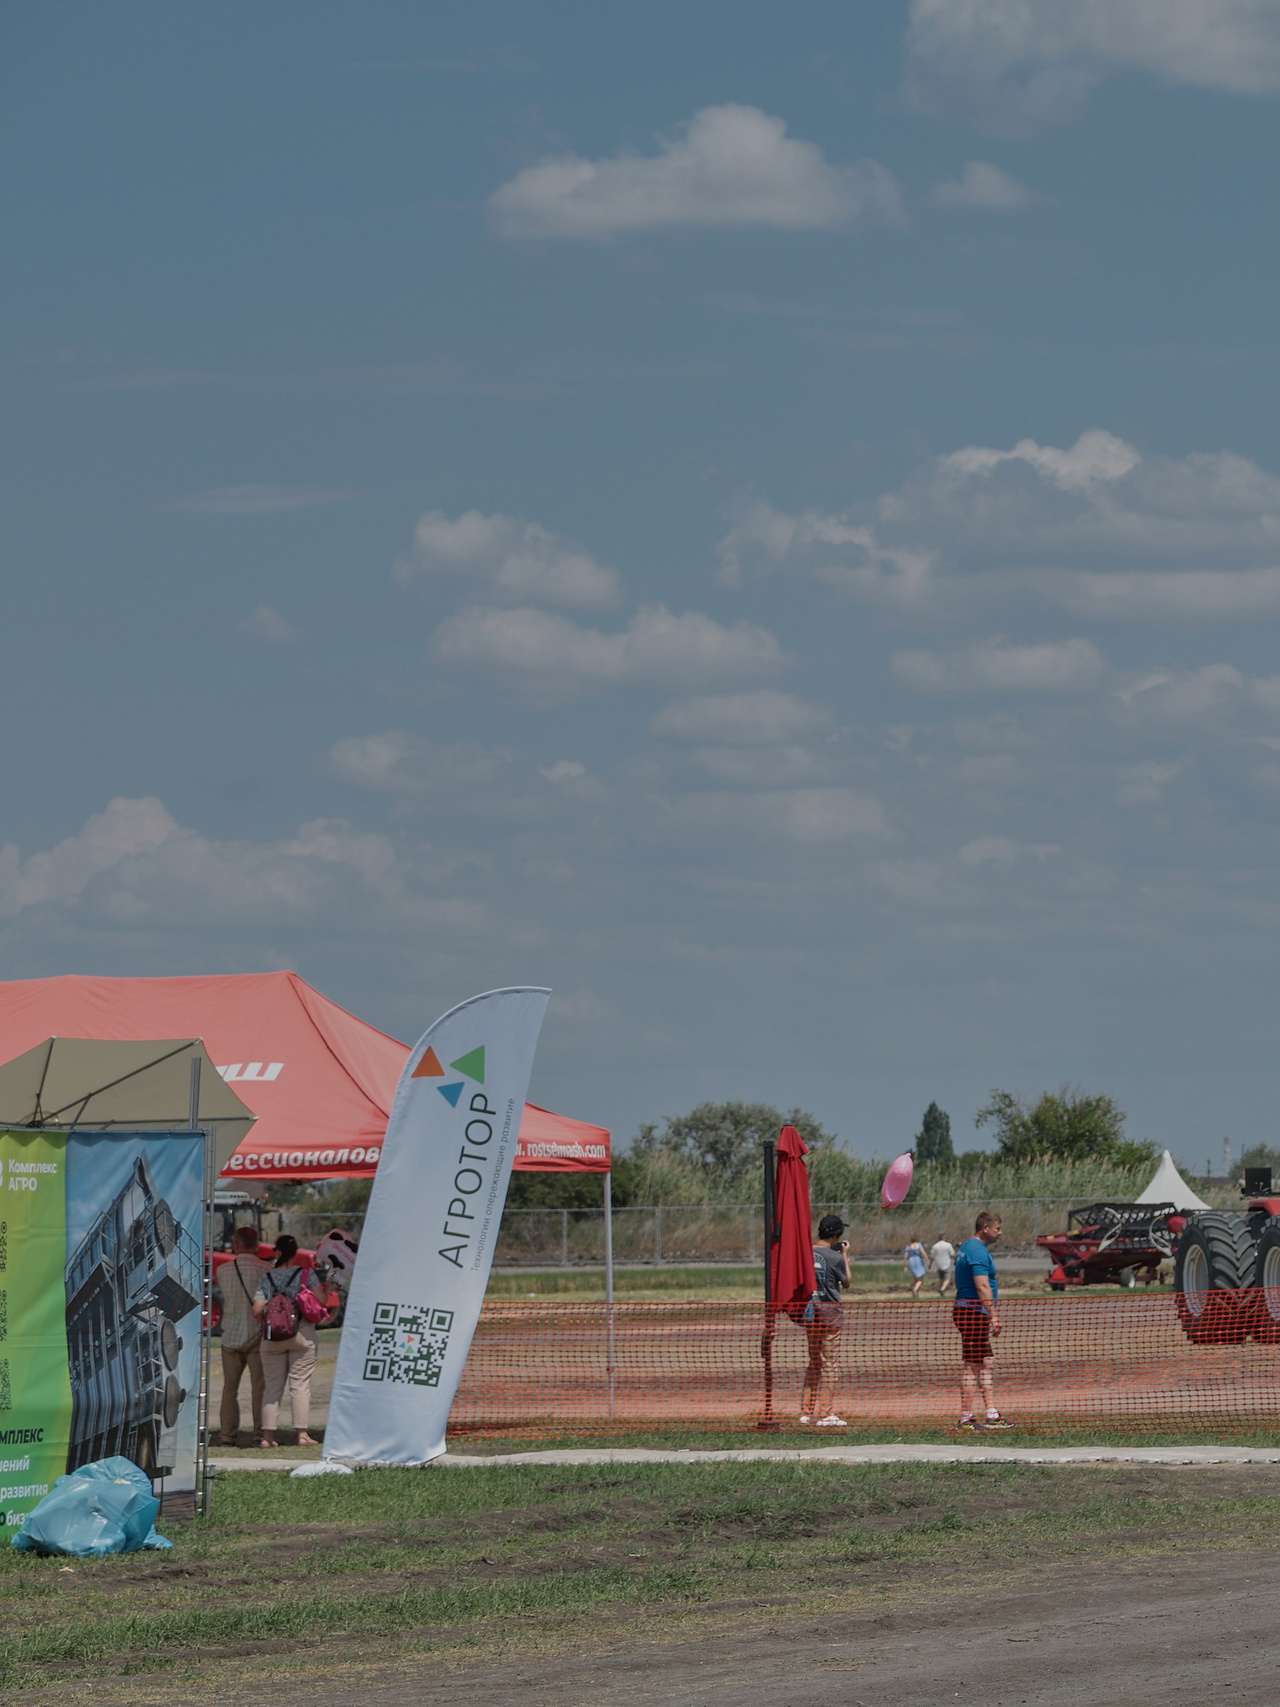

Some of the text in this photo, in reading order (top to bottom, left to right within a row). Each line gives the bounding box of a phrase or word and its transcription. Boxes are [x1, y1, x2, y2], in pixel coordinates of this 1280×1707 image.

[8, 1159, 58, 1174] Комплекс
[8, 1177, 37, 1191] АГРО
[438, 1093, 496, 1268] АГРОТОР
[471, 1098, 515, 1272] Технологии опережающие развитие
[0, 1484, 49, 1503] развития
